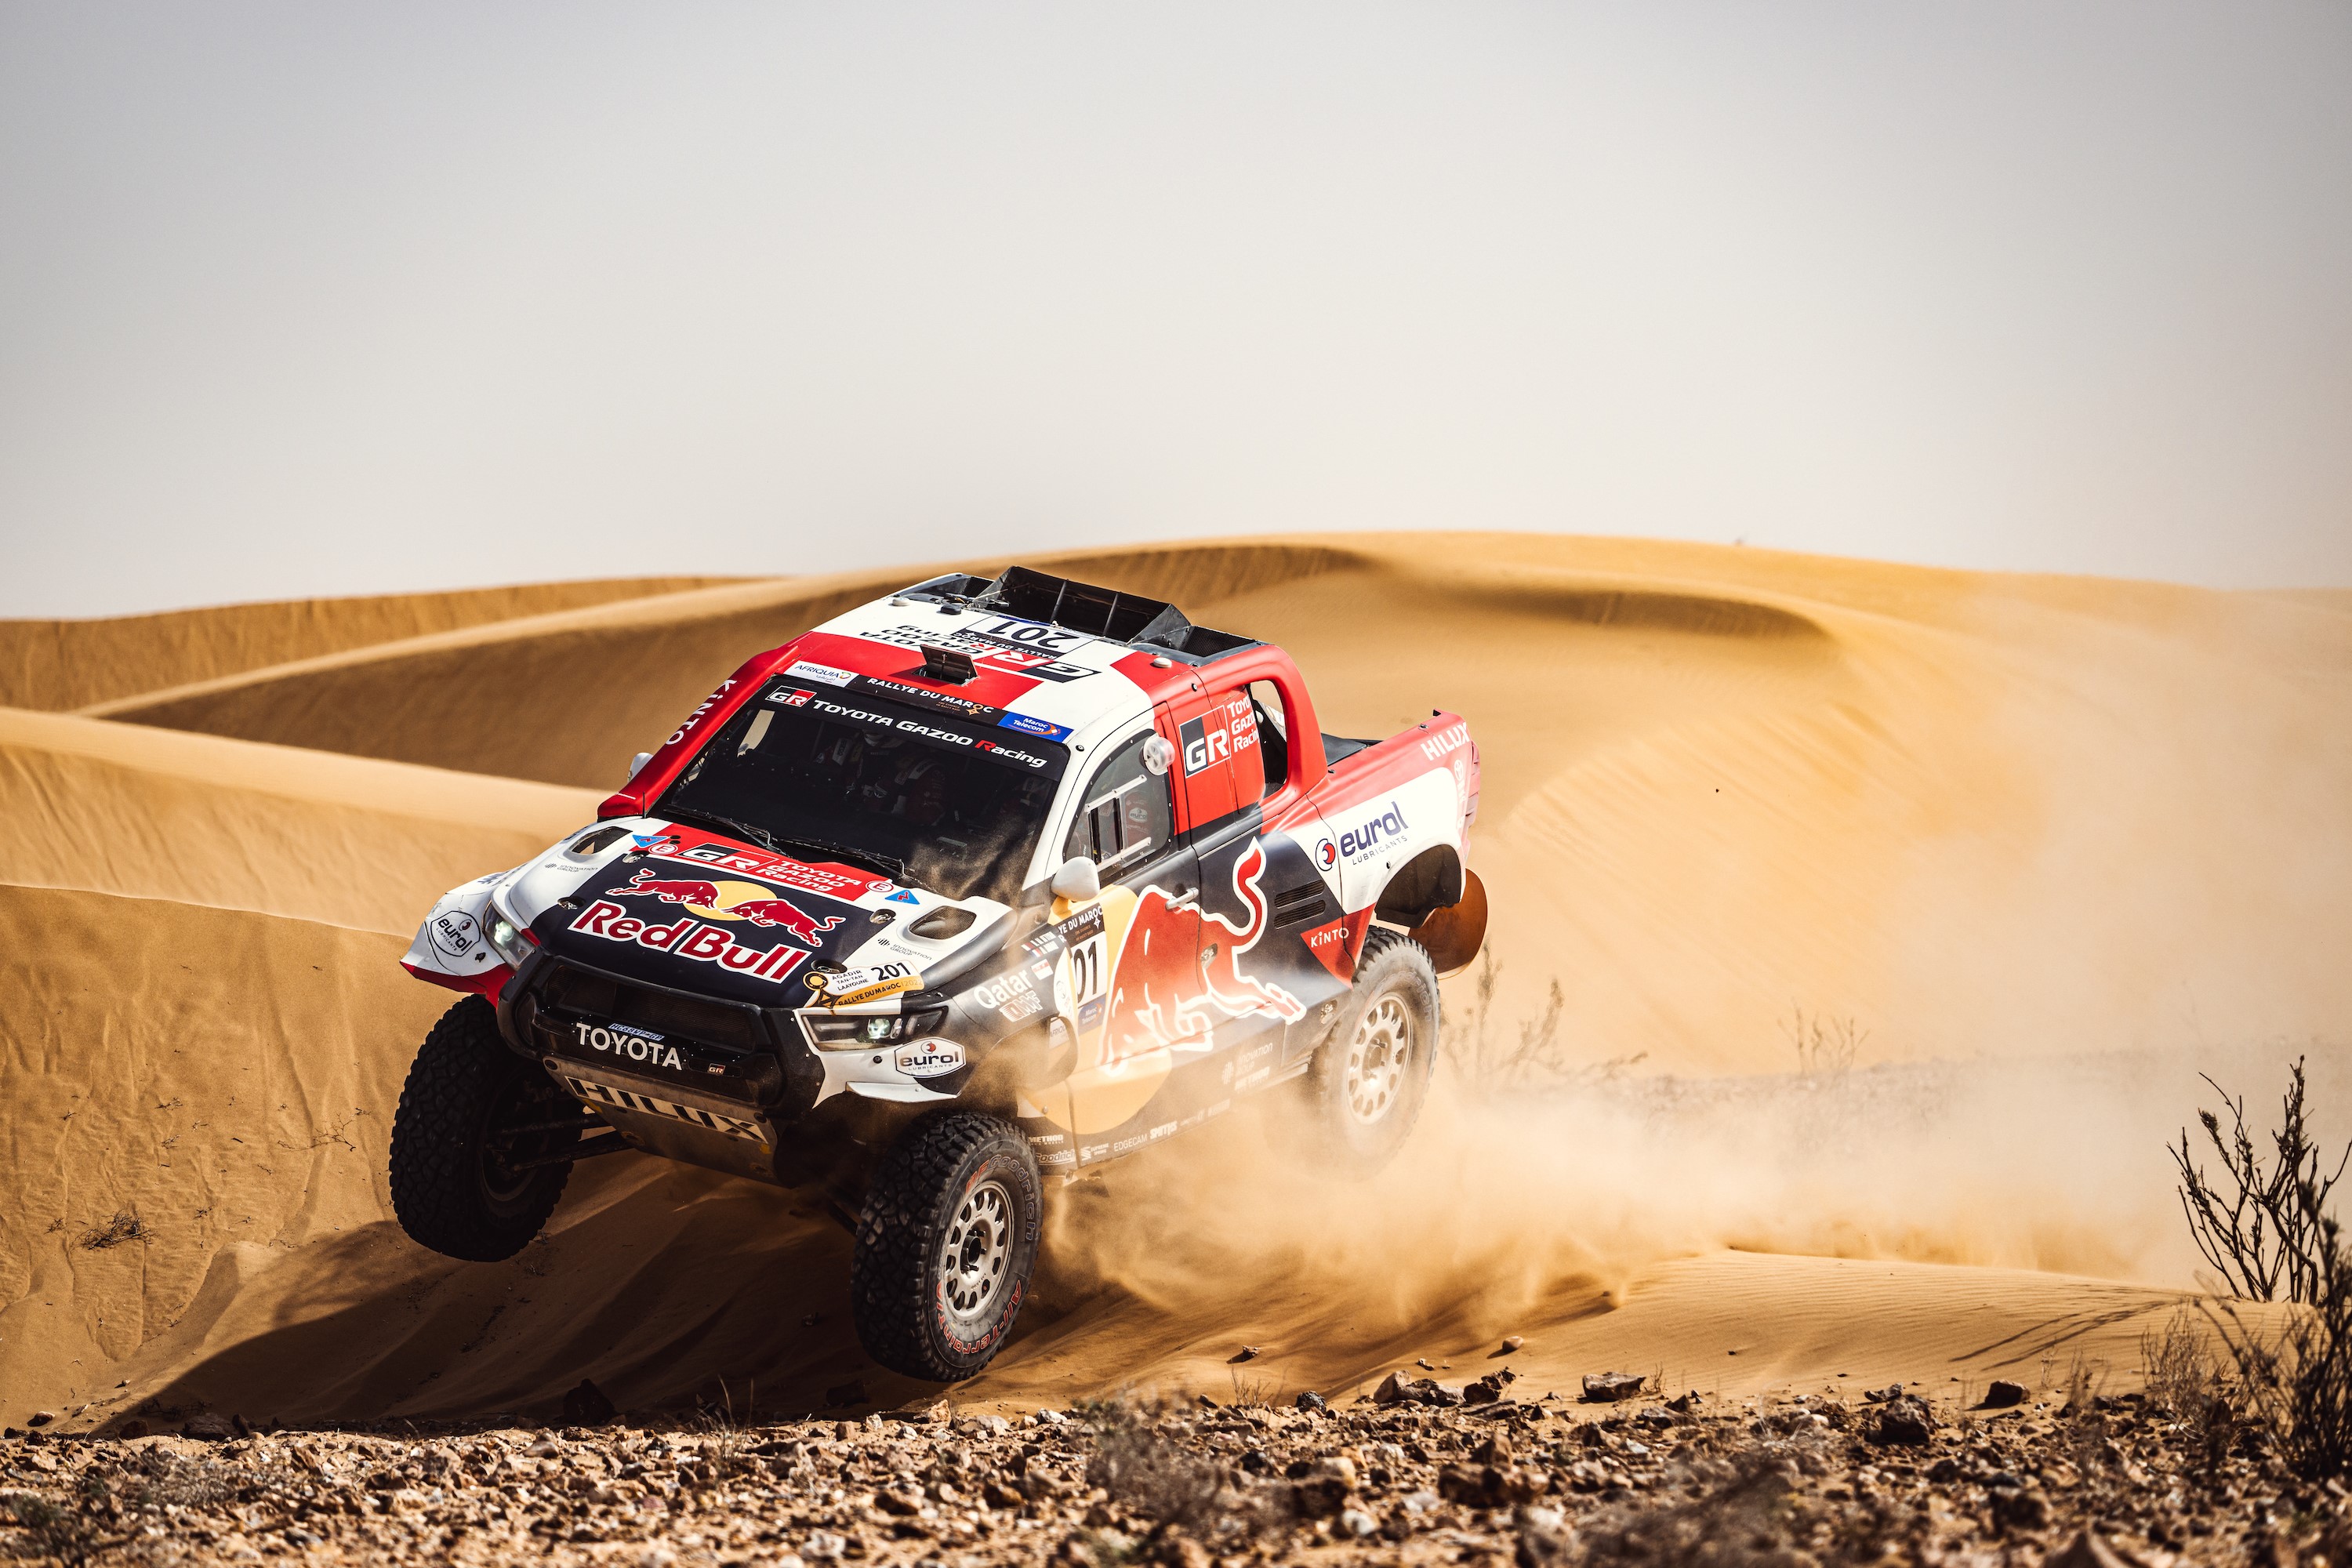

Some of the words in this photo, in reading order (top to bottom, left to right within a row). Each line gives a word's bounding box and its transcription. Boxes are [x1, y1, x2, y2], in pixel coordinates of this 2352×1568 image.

[986, 621, 1080, 648] 201
[996, 641, 1015, 651] DU
[993, 651, 1094, 678] GR
[1015, 647, 1058, 660] RALLYE
[794, 664, 840, 679] AFRIQUIA
[866, 677, 918, 695] RALLYE
[919, 689, 942, 700] DU
[942, 695, 995, 714] MAROC
[1227, 695, 1251, 717] TOYO
[769, 691, 808, 706] GR
[813, 699, 894, 727] TOYOTA
[895, 720, 974, 746] GAZOO
[975, 739, 1048, 768] Racing
[1013, 719, 1045, 733] Telecom
[1022, 717, 1049, 729] Maroc
[1231, 710, 1256, 735] GAZO
[1185, 728, 1230, 772] GR
[1420, 721, 1472, 761] HILUX
[1340, 800, 1410, 858] eurol
[682, 849, 760, 870] GR
[1352, 835, 1408, 866] LUBRICANTS
[757, 869, 834, 892] Racing
[769, 864, 845, 888] GAZOO
[779, 859, 862, 885] TOYOTA
[1069, 918, 1079, 931] DU
[1078, 905, 1103, 926] MAROC
[437, 918, 473, 952] eurol
[831, 969, 862, 981] AGADIR
[836, 975, 864, 985] TAN-TAN
[871, 961, 912, 982] 201
[1073, 940, 1098, 1005] 01
[837, 978, 869, 992] LAAYOUNE
[838, 993, 865, 1007] RALLYE
[874, 982, 902, 996] MAROC
[973, 969, 1033, 1009] Qatar
[576, 1022, 683, 1071] TOYOTA
[708, 1065, 724, 1075] GR
[899, 1051, 960, 1067] eurol
[566, 1076, 763, 1142] HILUX
[1028, 1134, 1064, 1143] METHOD
[1113, 1134, 1148, 1152] EDGECAM
[1034, 1148, 1076, 1162] Goodrich
[942, 1279, 1022, 1355] All-Terrain
